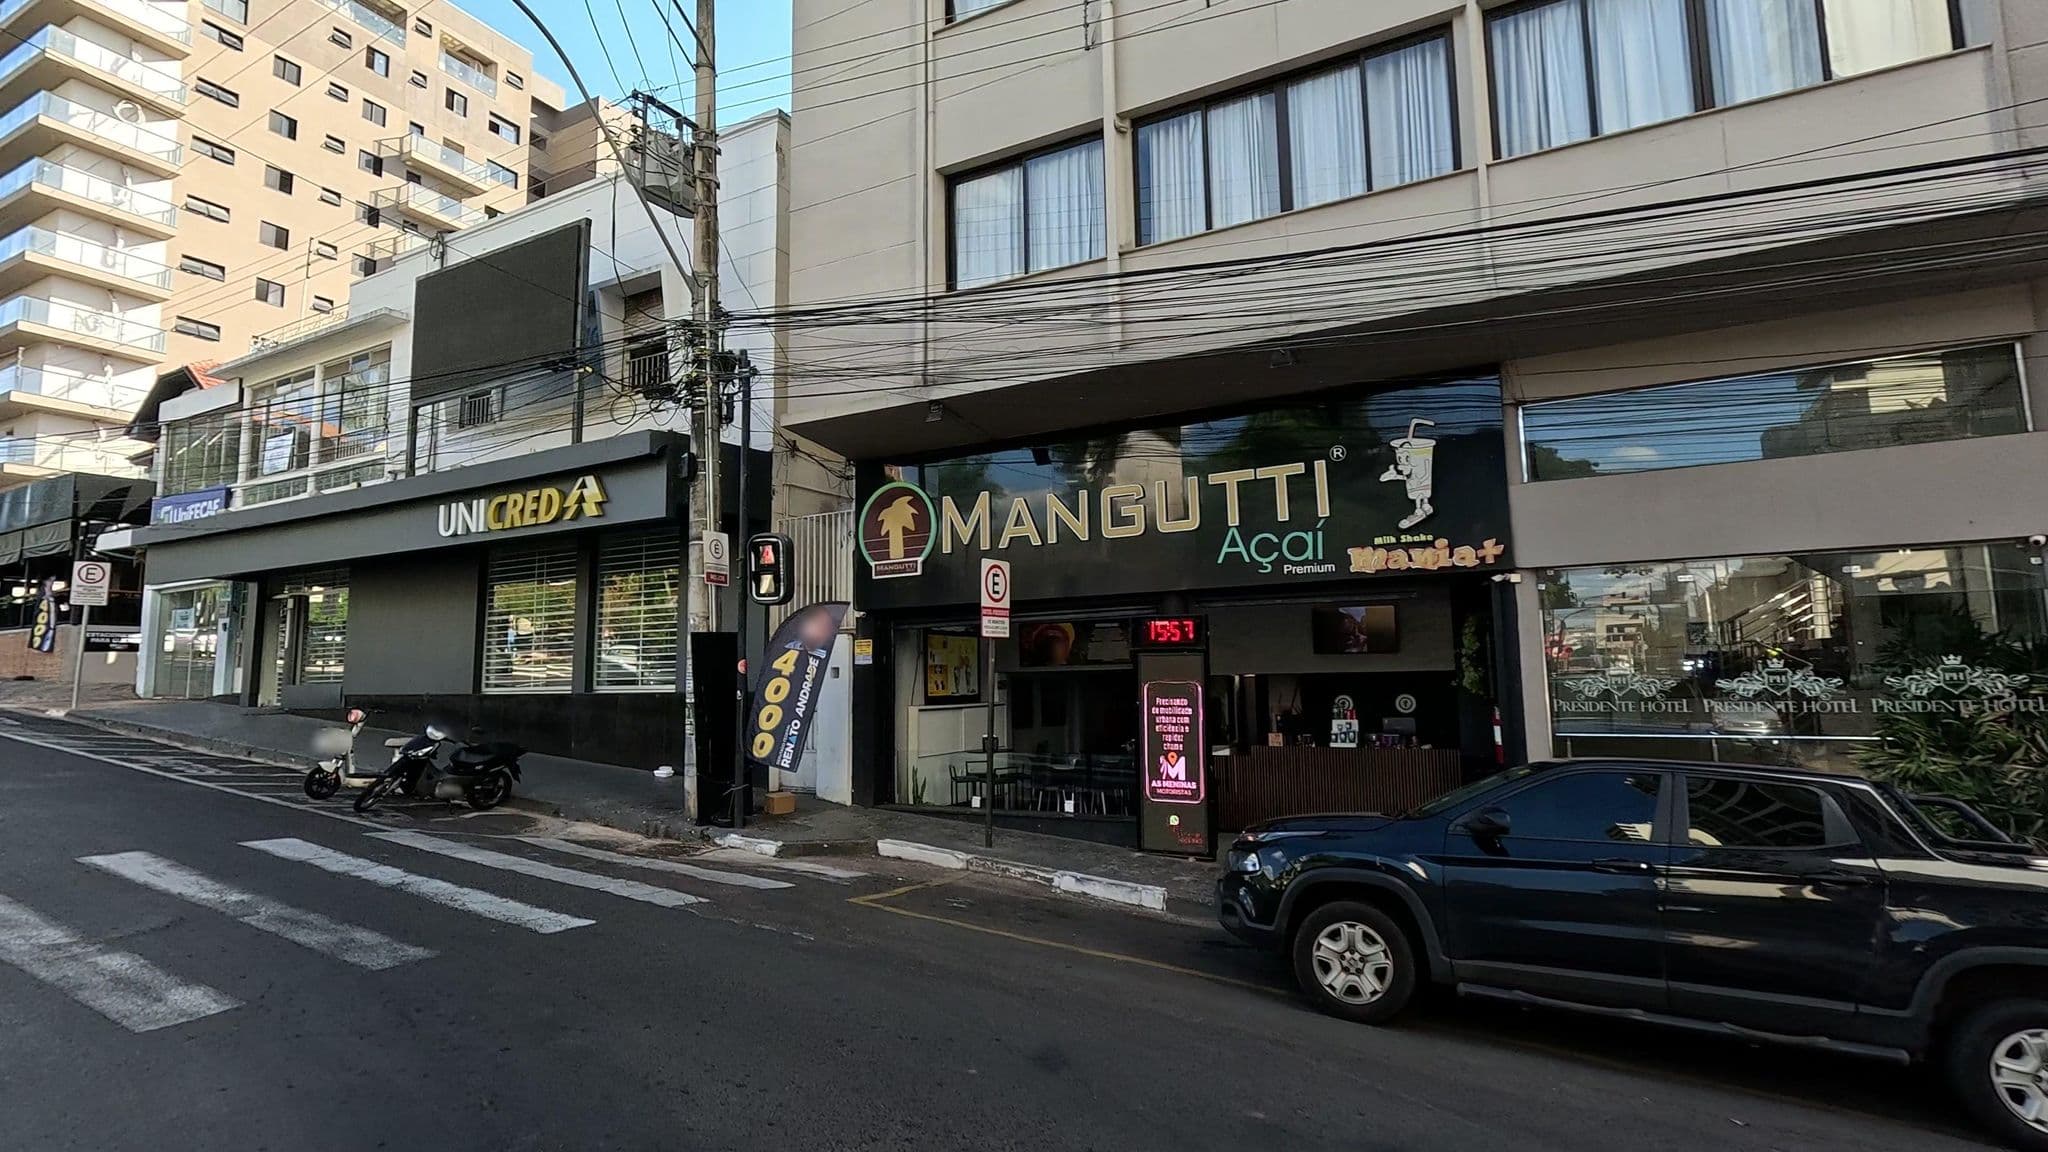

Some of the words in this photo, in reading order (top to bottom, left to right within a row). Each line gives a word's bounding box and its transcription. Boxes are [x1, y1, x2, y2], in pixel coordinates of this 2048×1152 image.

[438, 487, 564, 537] UNICRED
[942, 459, 1330, 554] MANGUTTI
[1217, 518, 1326, 573] Açaí
[1374, 536, 1396, 545] Milk
[1400, 534, 1433, 543] Shake
[85, 567, 97, 580] E
[1283, 563, 1336, 574] Premium
[992, 573, 1000, 594] E
[752, 649, 800, 759] 4000
[780, 719, 801, 769] RENATO
[795, 655, 820, 718] ANDRADE
[1553, 700, 1636, 713] PRESIDENTE
[1704, 700, 1799, 713] PRESIDENTE
[1872, 698, 1977, 713] PRESIDENTE
